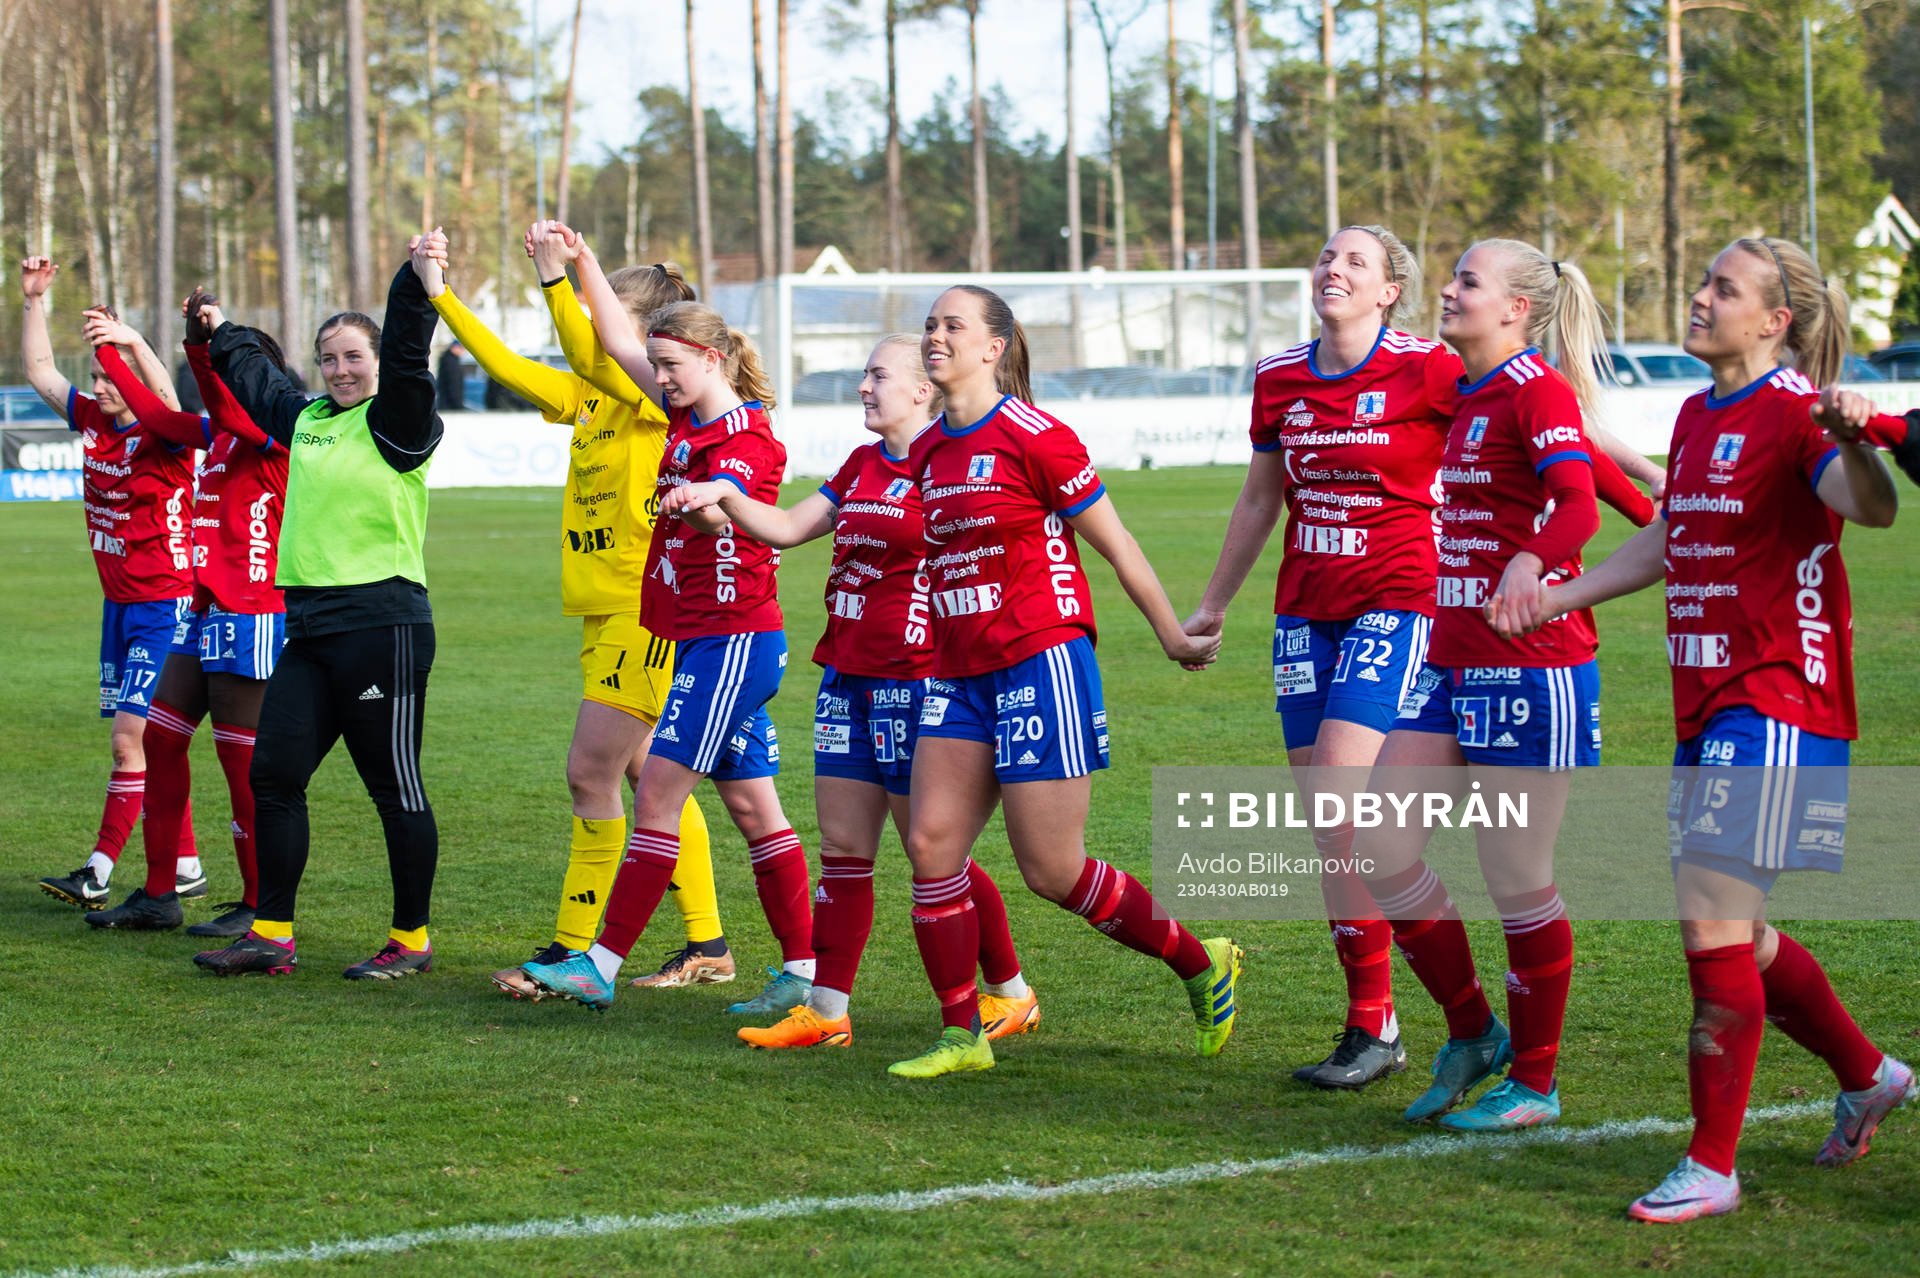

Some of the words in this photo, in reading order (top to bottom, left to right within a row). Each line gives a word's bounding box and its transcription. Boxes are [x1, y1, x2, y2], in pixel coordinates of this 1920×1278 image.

[1302, 503, 1349, 522] Sparbank
[1356, 612, 1400, 633] SAB
[1795, 543, 1834, 686] eolus
[225, 622, 236, 642] 3
[1356, 638, 1393, 667] 22
[134, 668, 157, 689] 17
[667, 699, 684, 722] 5
[1498, 695, 1531, 726] 19
[1011, 715, 1044, 742] 20
[1702, 777, 1732, 809] 15
